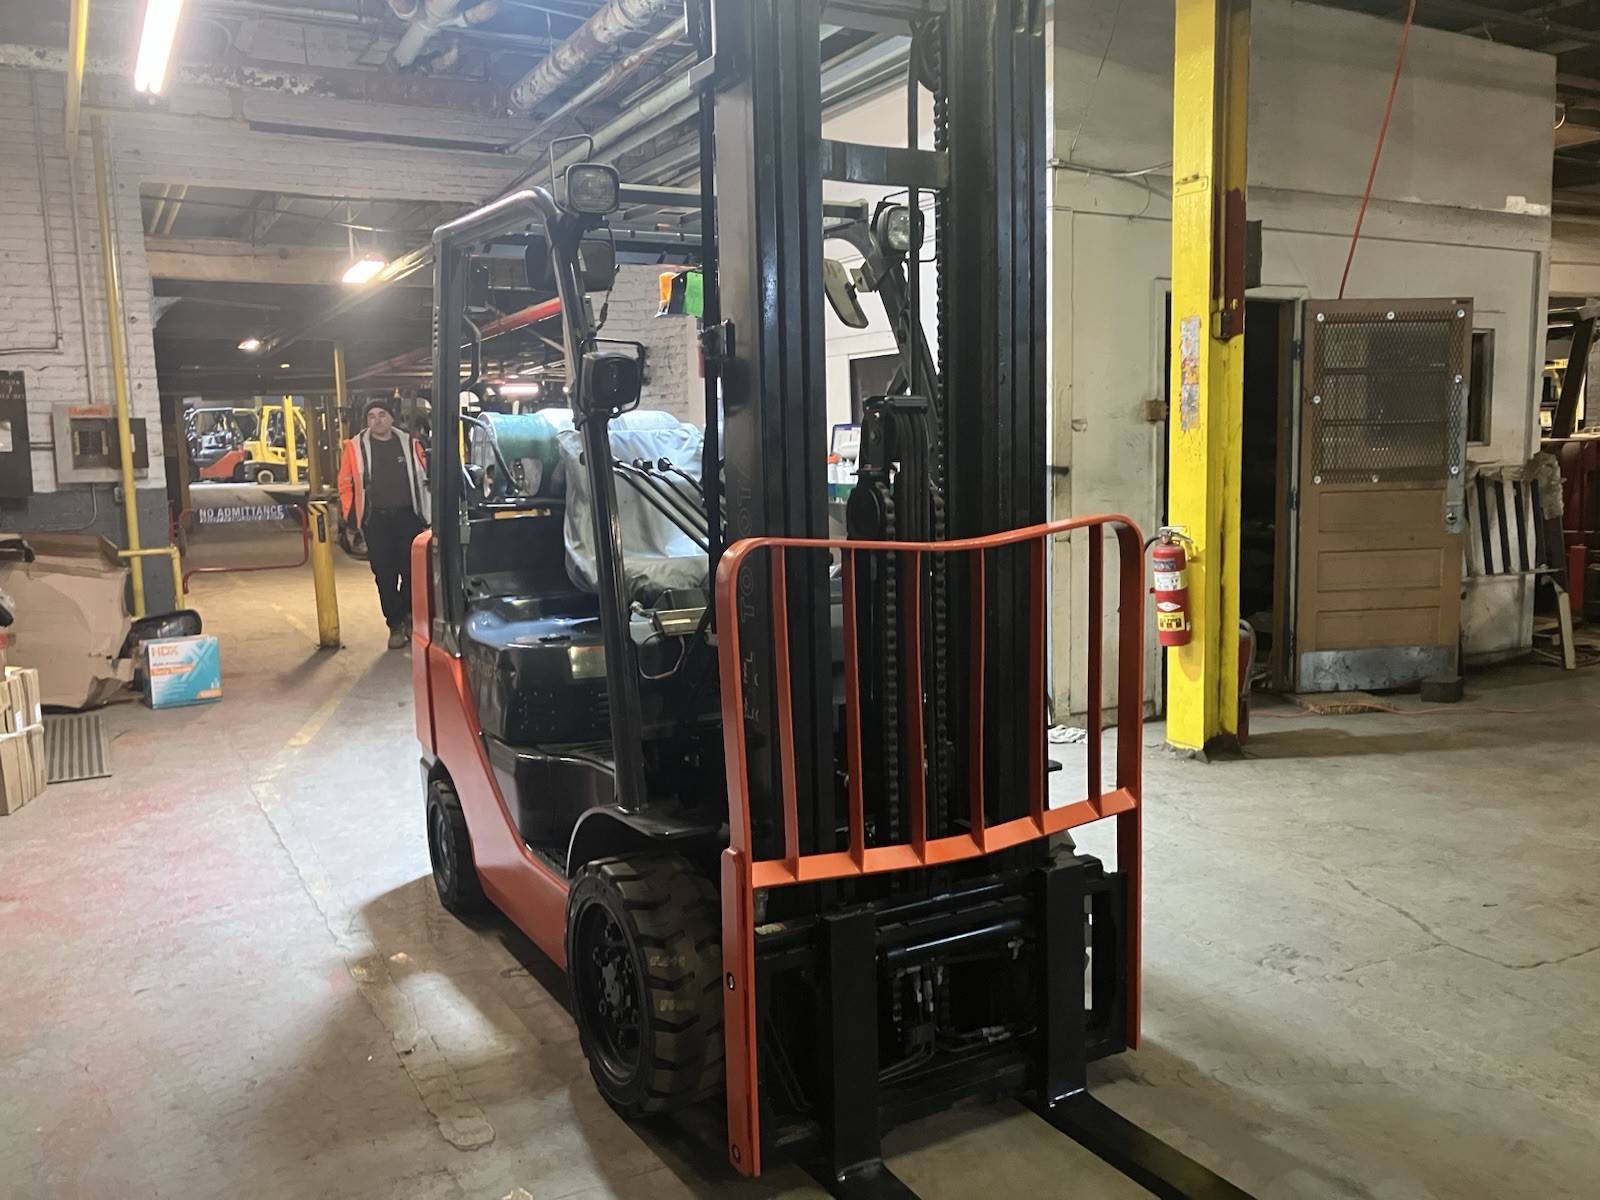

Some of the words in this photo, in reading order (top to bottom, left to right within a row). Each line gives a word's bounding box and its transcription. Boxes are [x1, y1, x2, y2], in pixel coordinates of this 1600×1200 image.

[199, 508, 214, 518] NO
[217, 505, 283, 518] ADMITTANCE
[736, 446, 755, 623] TOOTA
[152, 646, 179, 657] HDX
